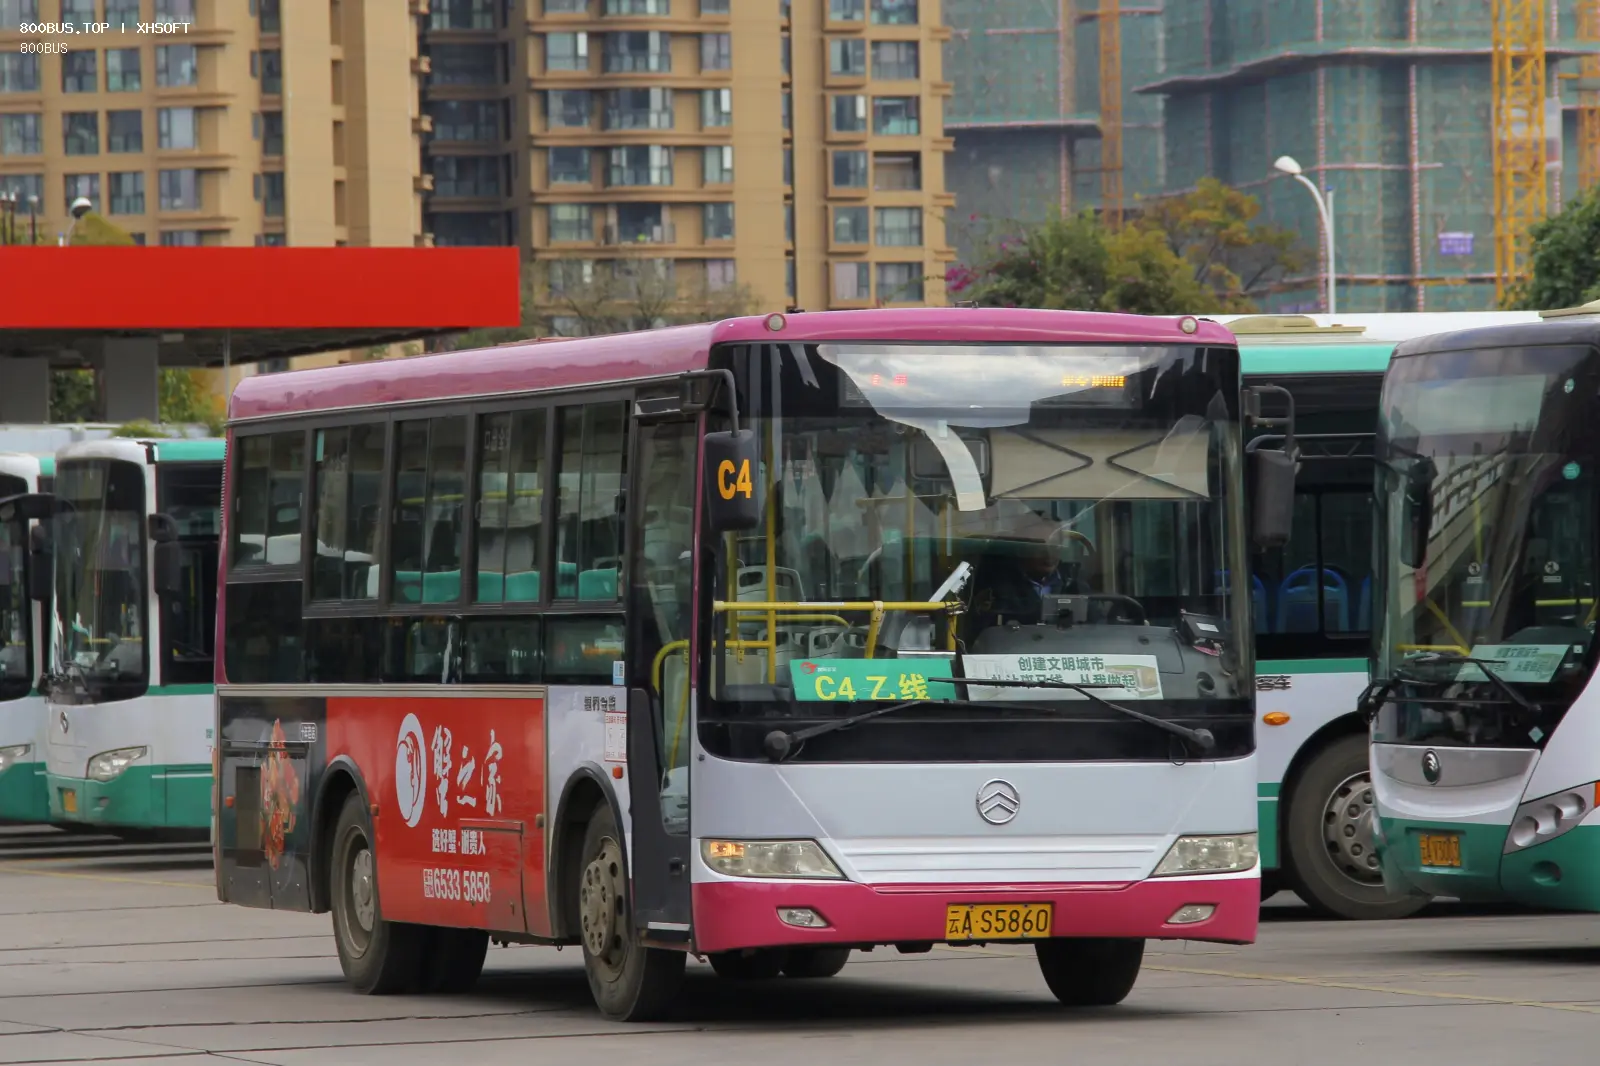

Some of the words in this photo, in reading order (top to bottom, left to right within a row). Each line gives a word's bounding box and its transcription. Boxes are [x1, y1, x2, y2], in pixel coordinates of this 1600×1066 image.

[718, 459, 752, 500] C4
[1018, 656, 1104, 672] 创建文明城市
[815, 675, 857, 700] C4
[865, 673, 931, 700] 乙线
[434, 868, 460, 900] 6533
[463, 871, 491, 903] 5858
